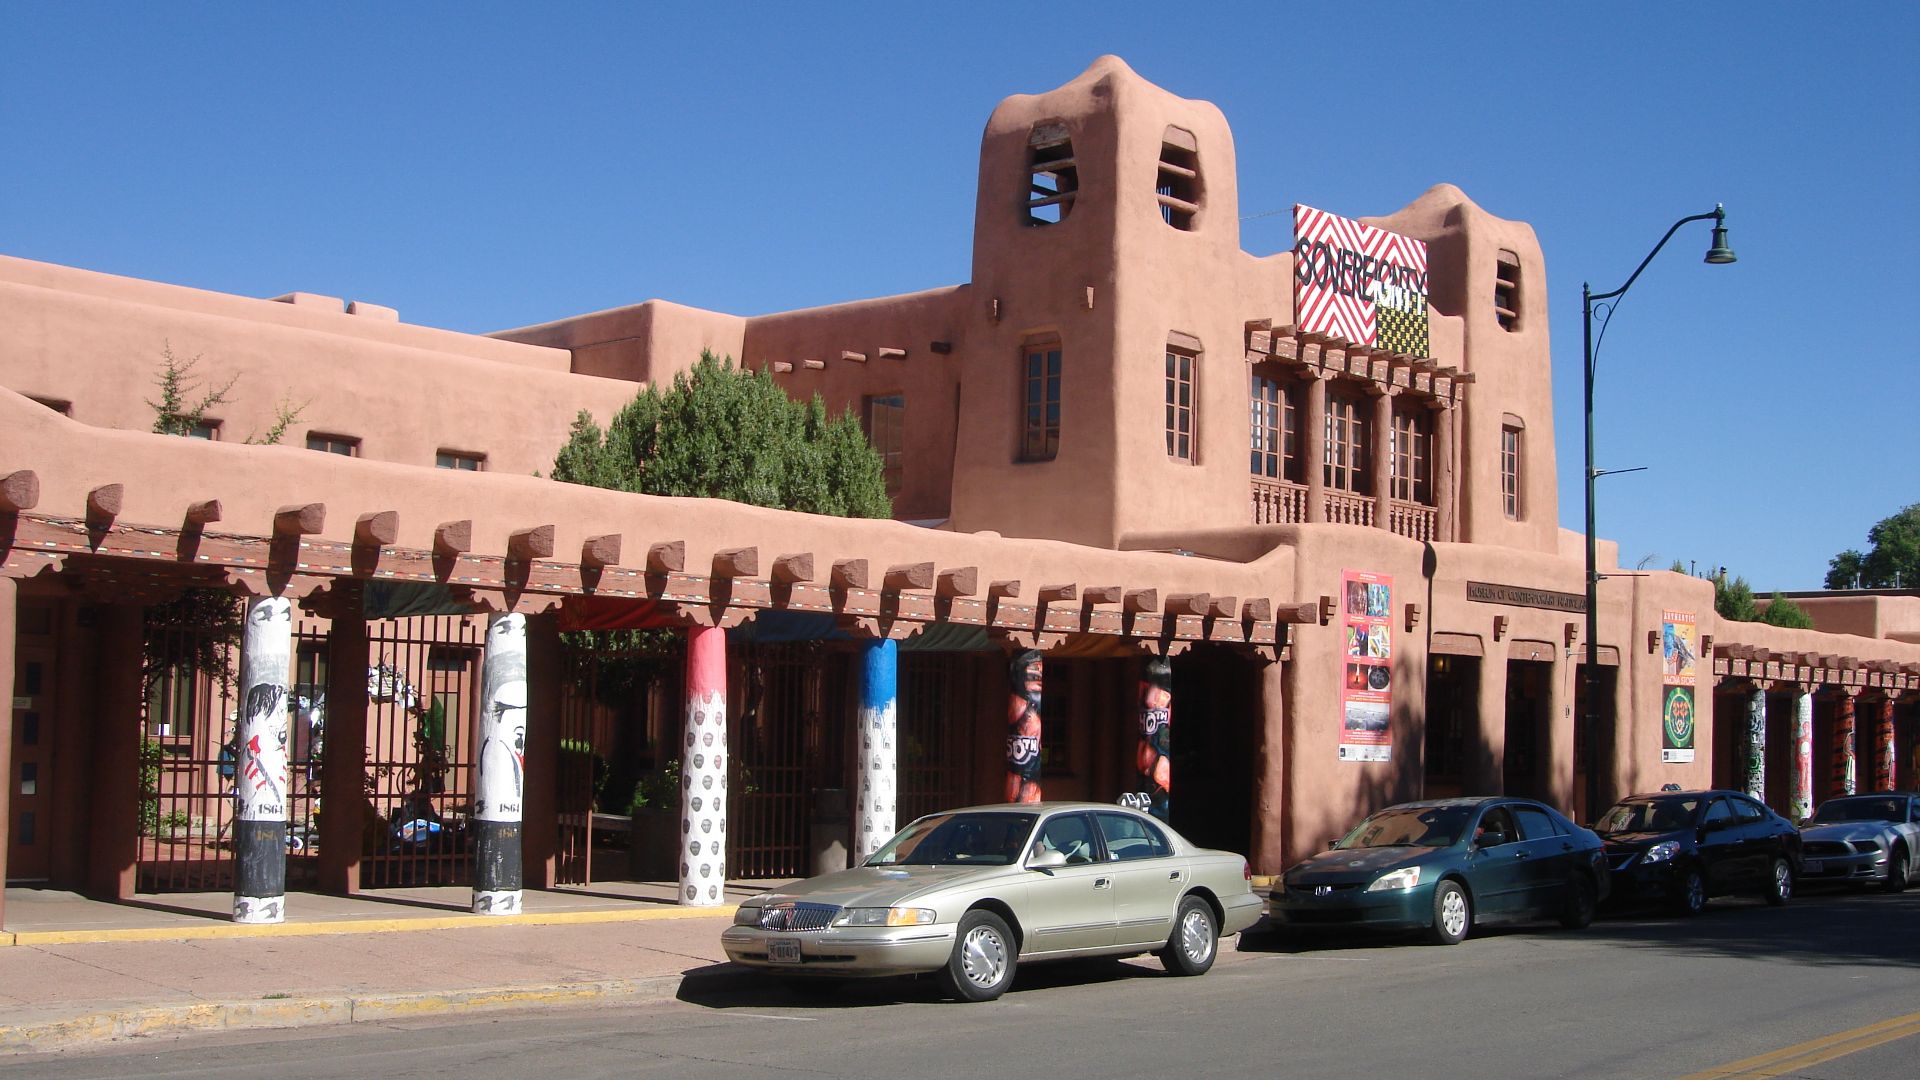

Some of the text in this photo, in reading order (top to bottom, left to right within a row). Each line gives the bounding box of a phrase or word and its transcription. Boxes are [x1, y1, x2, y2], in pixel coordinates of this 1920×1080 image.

[1296, 236, 1427, 316] SOVEREIGNTY
[1469, 585, 1496, 599] MUSEUM
[1497, 590, 1505, 600] OF
[1680, 676, 1696, 686] STORE
